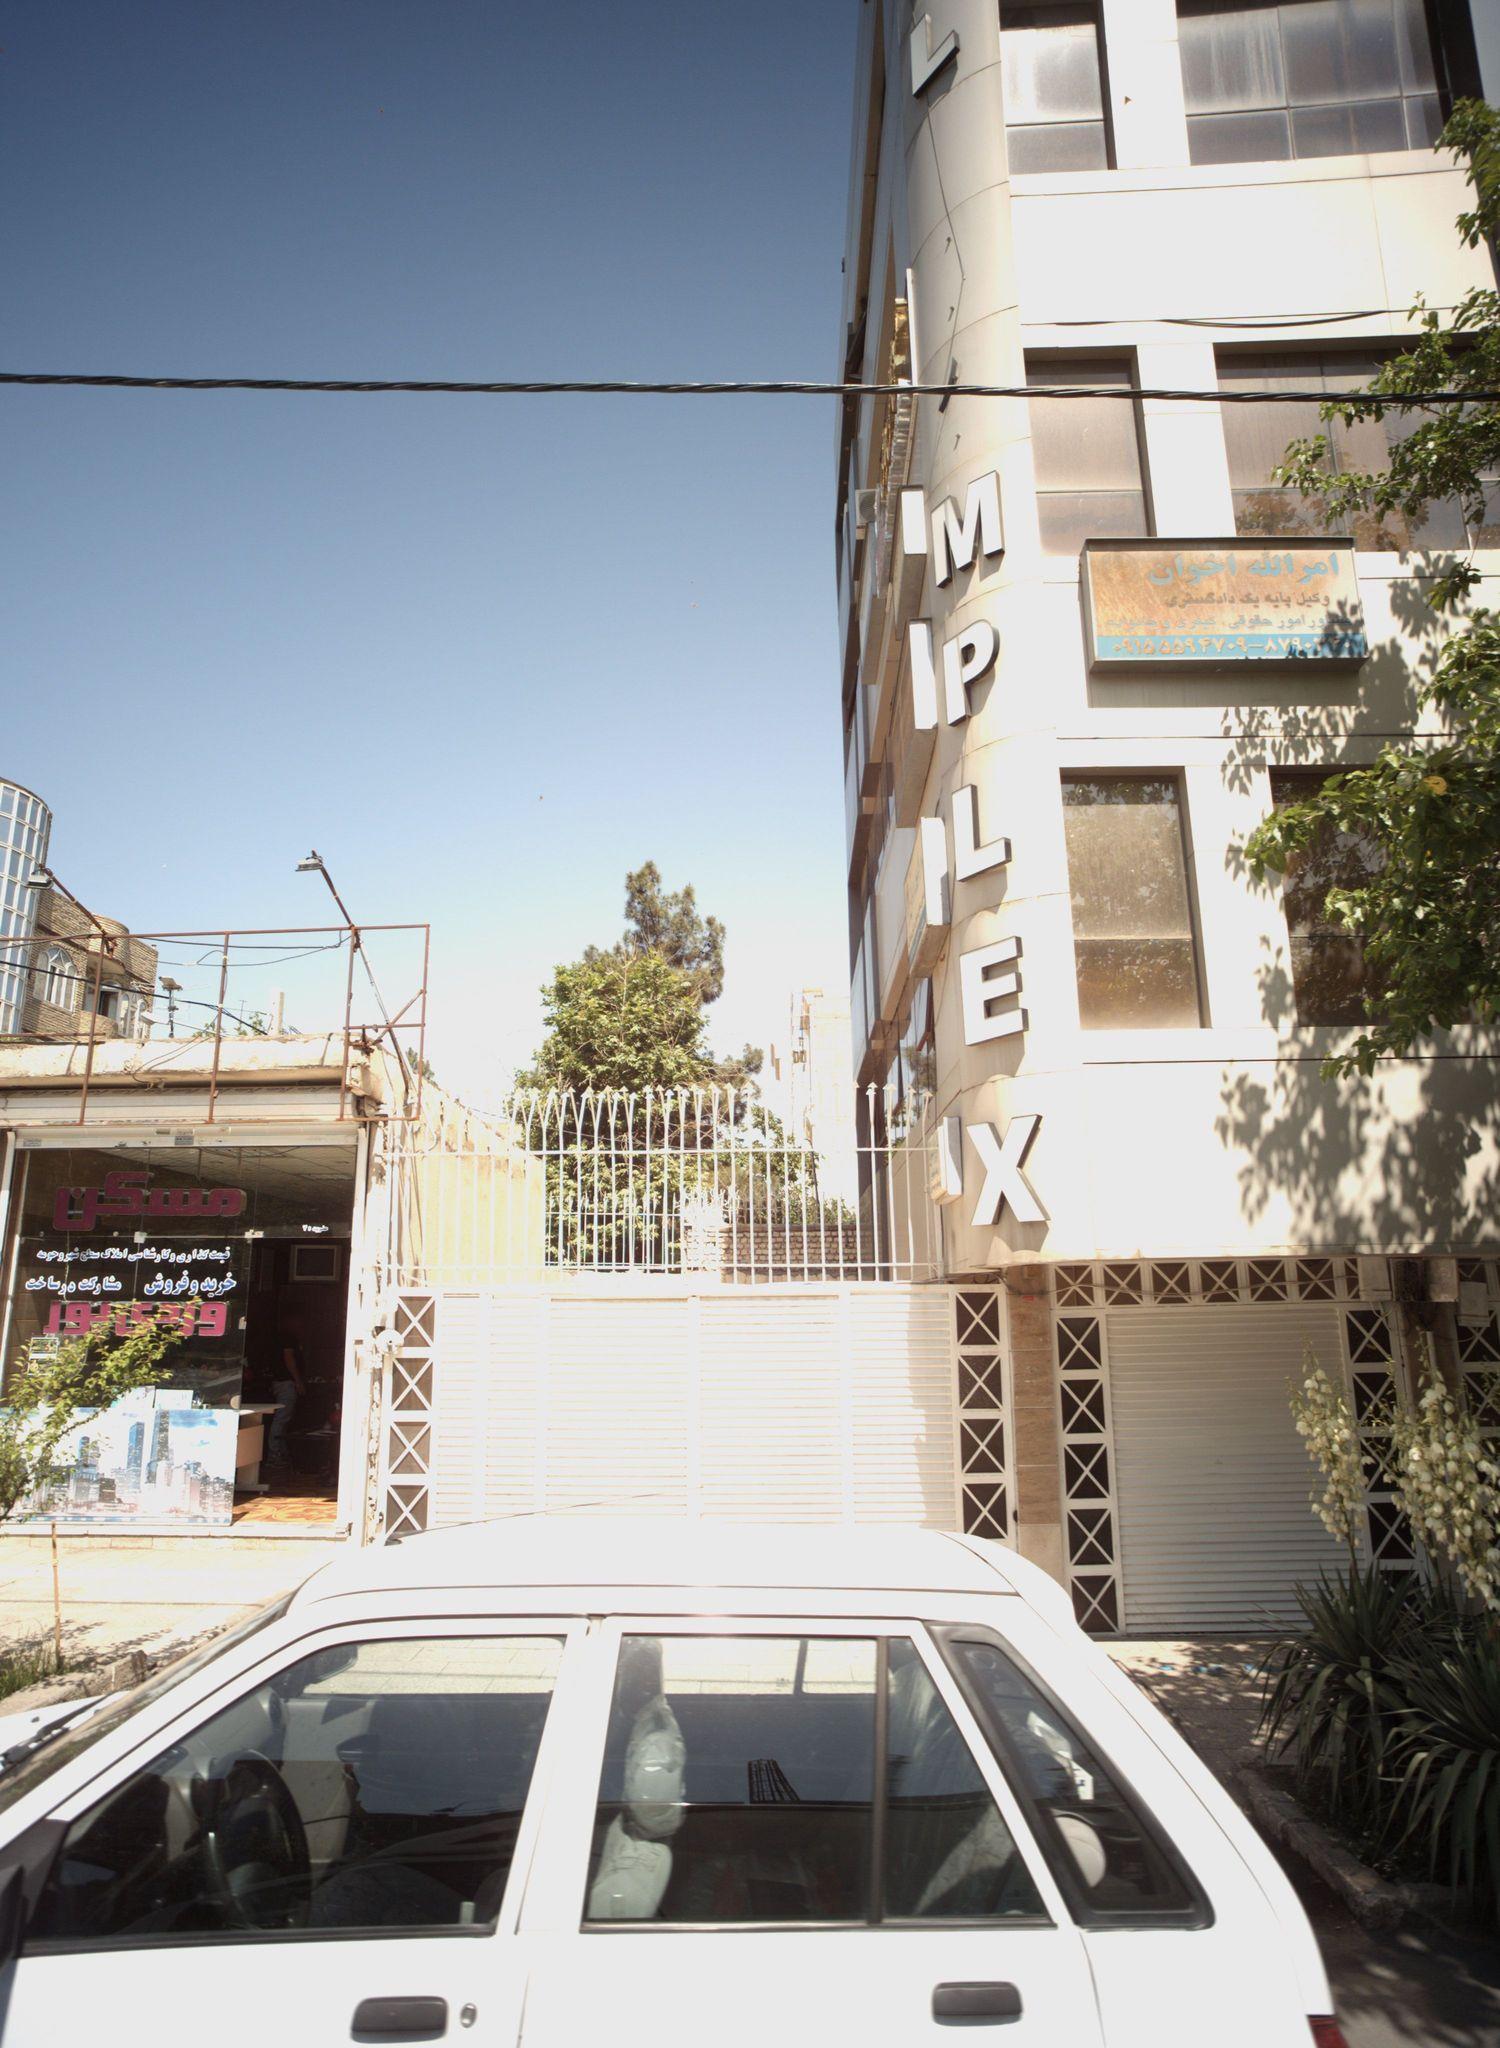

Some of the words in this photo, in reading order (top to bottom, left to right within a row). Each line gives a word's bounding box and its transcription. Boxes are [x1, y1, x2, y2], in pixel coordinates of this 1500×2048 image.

[1248, 551, 1293, 577] الله
[1297, 552, 1340, 584] امر
[1164, 591, 1236, 609] دادگستری
[1264, 592, 1292, 608] پایه
[1297, 592, 1330, 608] وکیل
[53, 1171, 247, 1231] مسکن
[36, 1250, 58, 1261] حومه
[64, 1247, 80, 1262] شهر
[80, 1248, 100, 1261] سطح
[101, 1247, 129, 1260] املاک
[128, 1247, 171, 1263] کارشناسی
[209, 1246, 231, 1264] قیمت
[25, 1275, 60, 1291] ساخت
[58, 1280, 76, 1295] در
[78, 1275, 122, 1295] مشارکت
[144, 1270, 190, 1296] فروش
[188, 1279, 199, 1296] و
[200, 1271, 237, 1297] خرید
